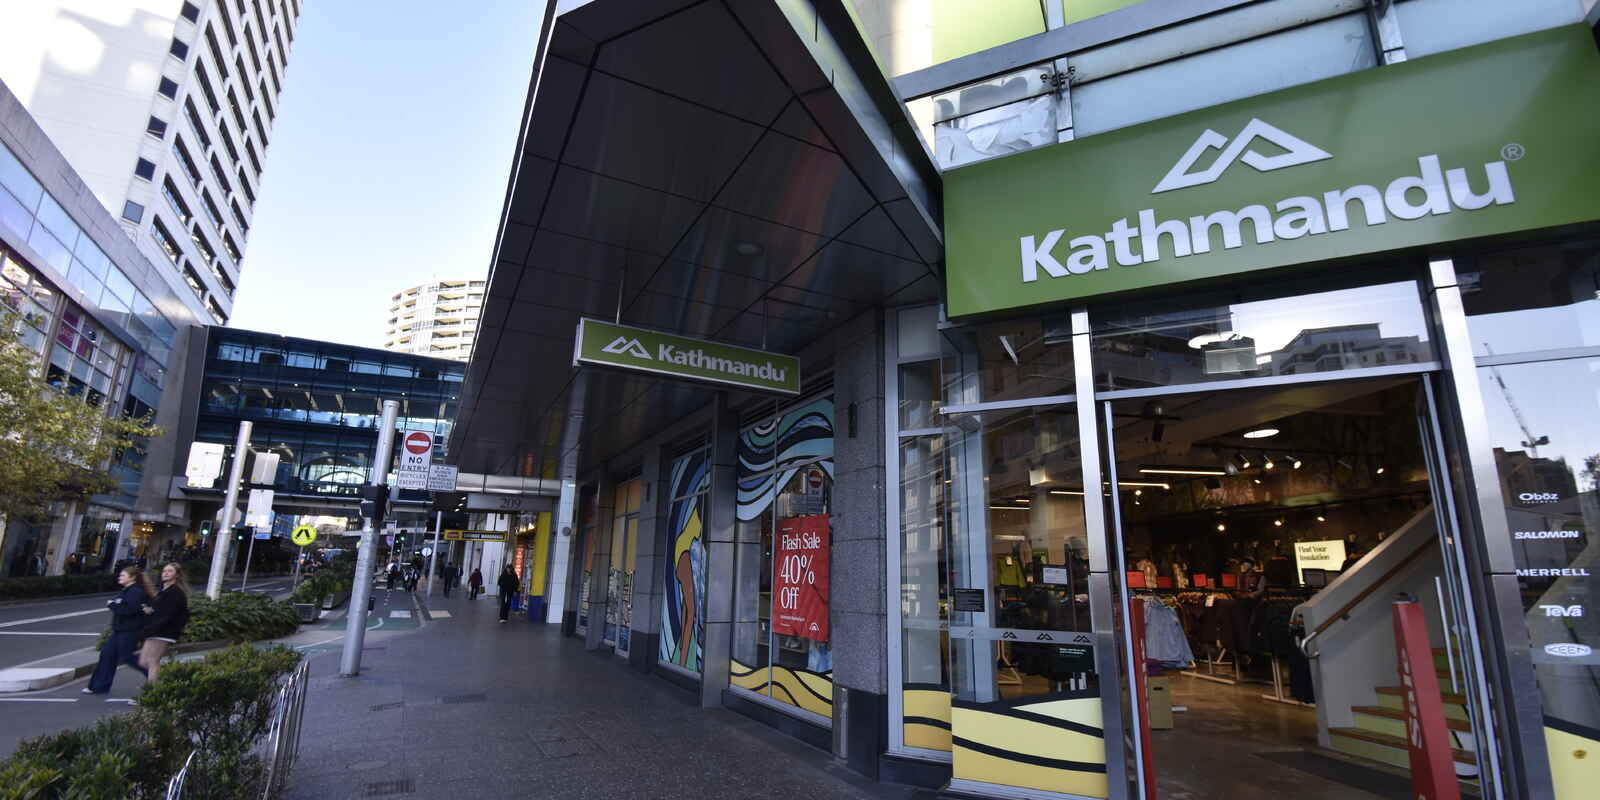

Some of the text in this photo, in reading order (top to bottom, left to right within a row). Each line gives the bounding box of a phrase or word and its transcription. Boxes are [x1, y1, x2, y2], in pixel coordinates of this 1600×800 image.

[1020, 154, 1515, 282] Kathmandu
[658, 343, 785, 382] Kathmandu
[500, 496, 521, 508] 209
[782, 531, 821, 550] Flash Sale
[1514, 531, 1579, 539] SALOMON
[781, 554, 815, 585] 40%
[1515, 568, 1592, 577] MERRELL
[781, 586, 800, 609] Off
[1547, 646, 1588, 656] KEEN
